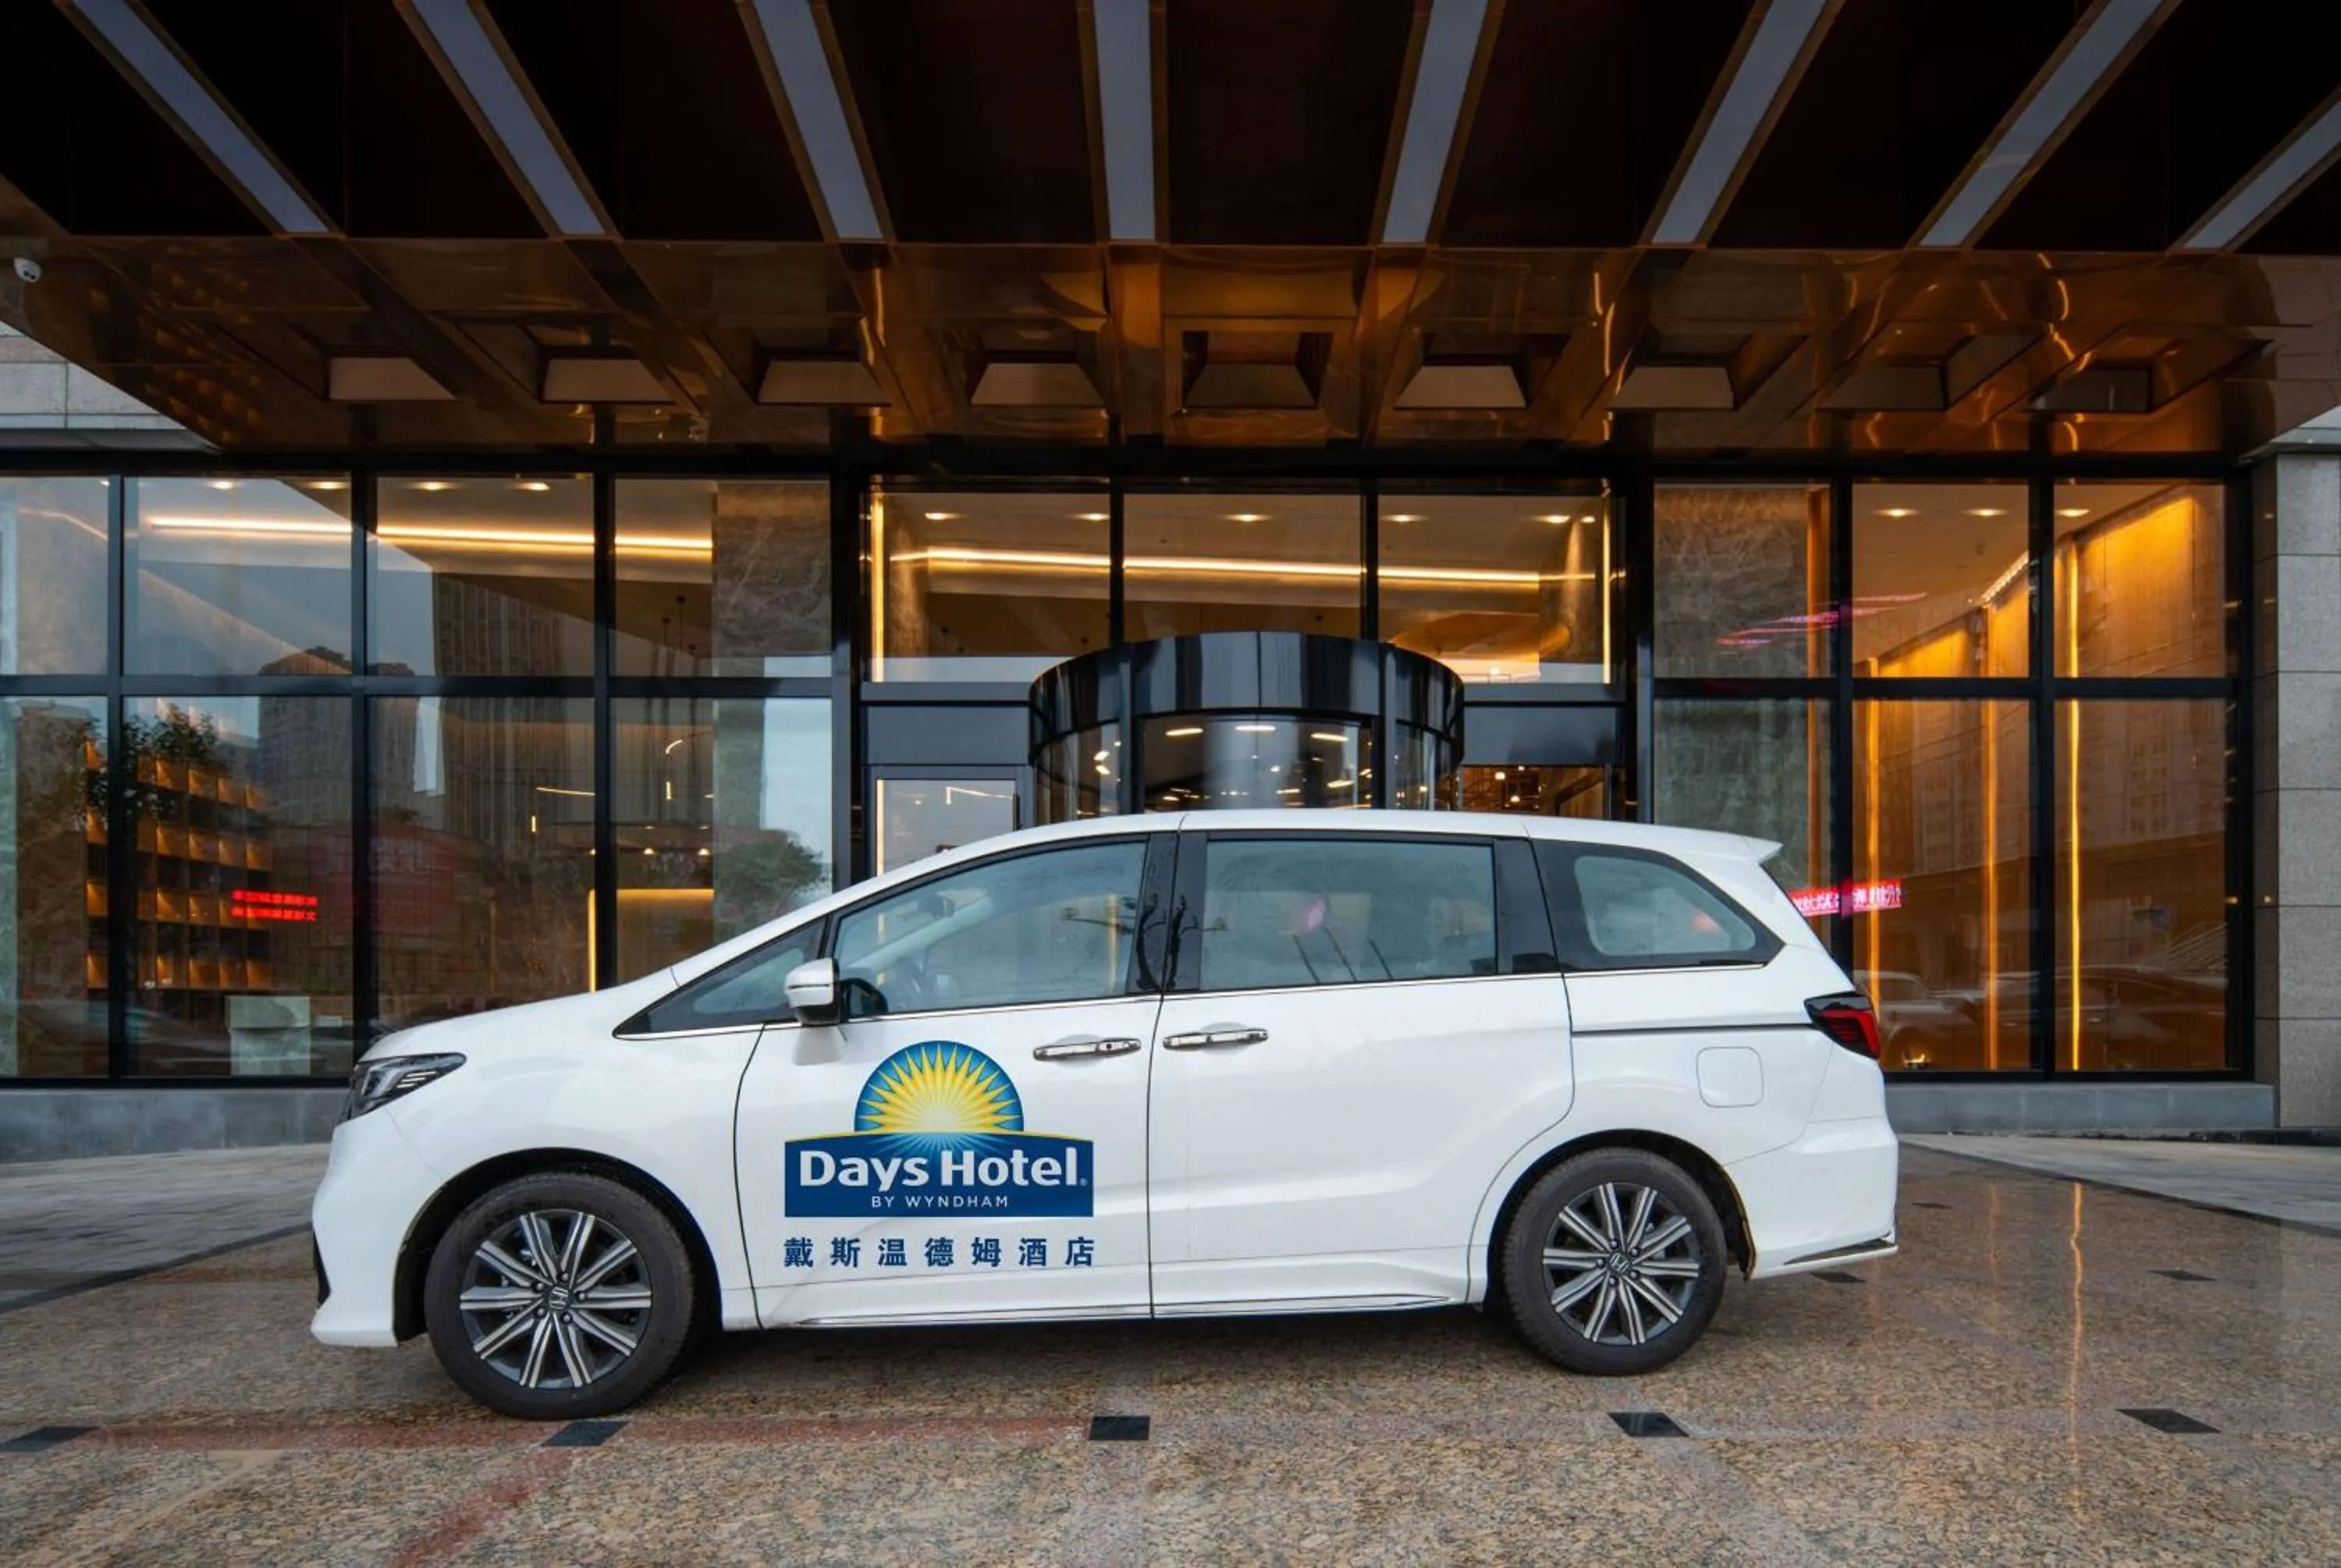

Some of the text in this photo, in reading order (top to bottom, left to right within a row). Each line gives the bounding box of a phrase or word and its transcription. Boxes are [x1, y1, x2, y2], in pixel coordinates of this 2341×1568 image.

[800, 1147, 1077, 1192] Days Hotel
[871, 1196, 1009, 1208] BY WYNDHAM
[783, 1237, 1095, 1268] 戴斯温德姆酒店
